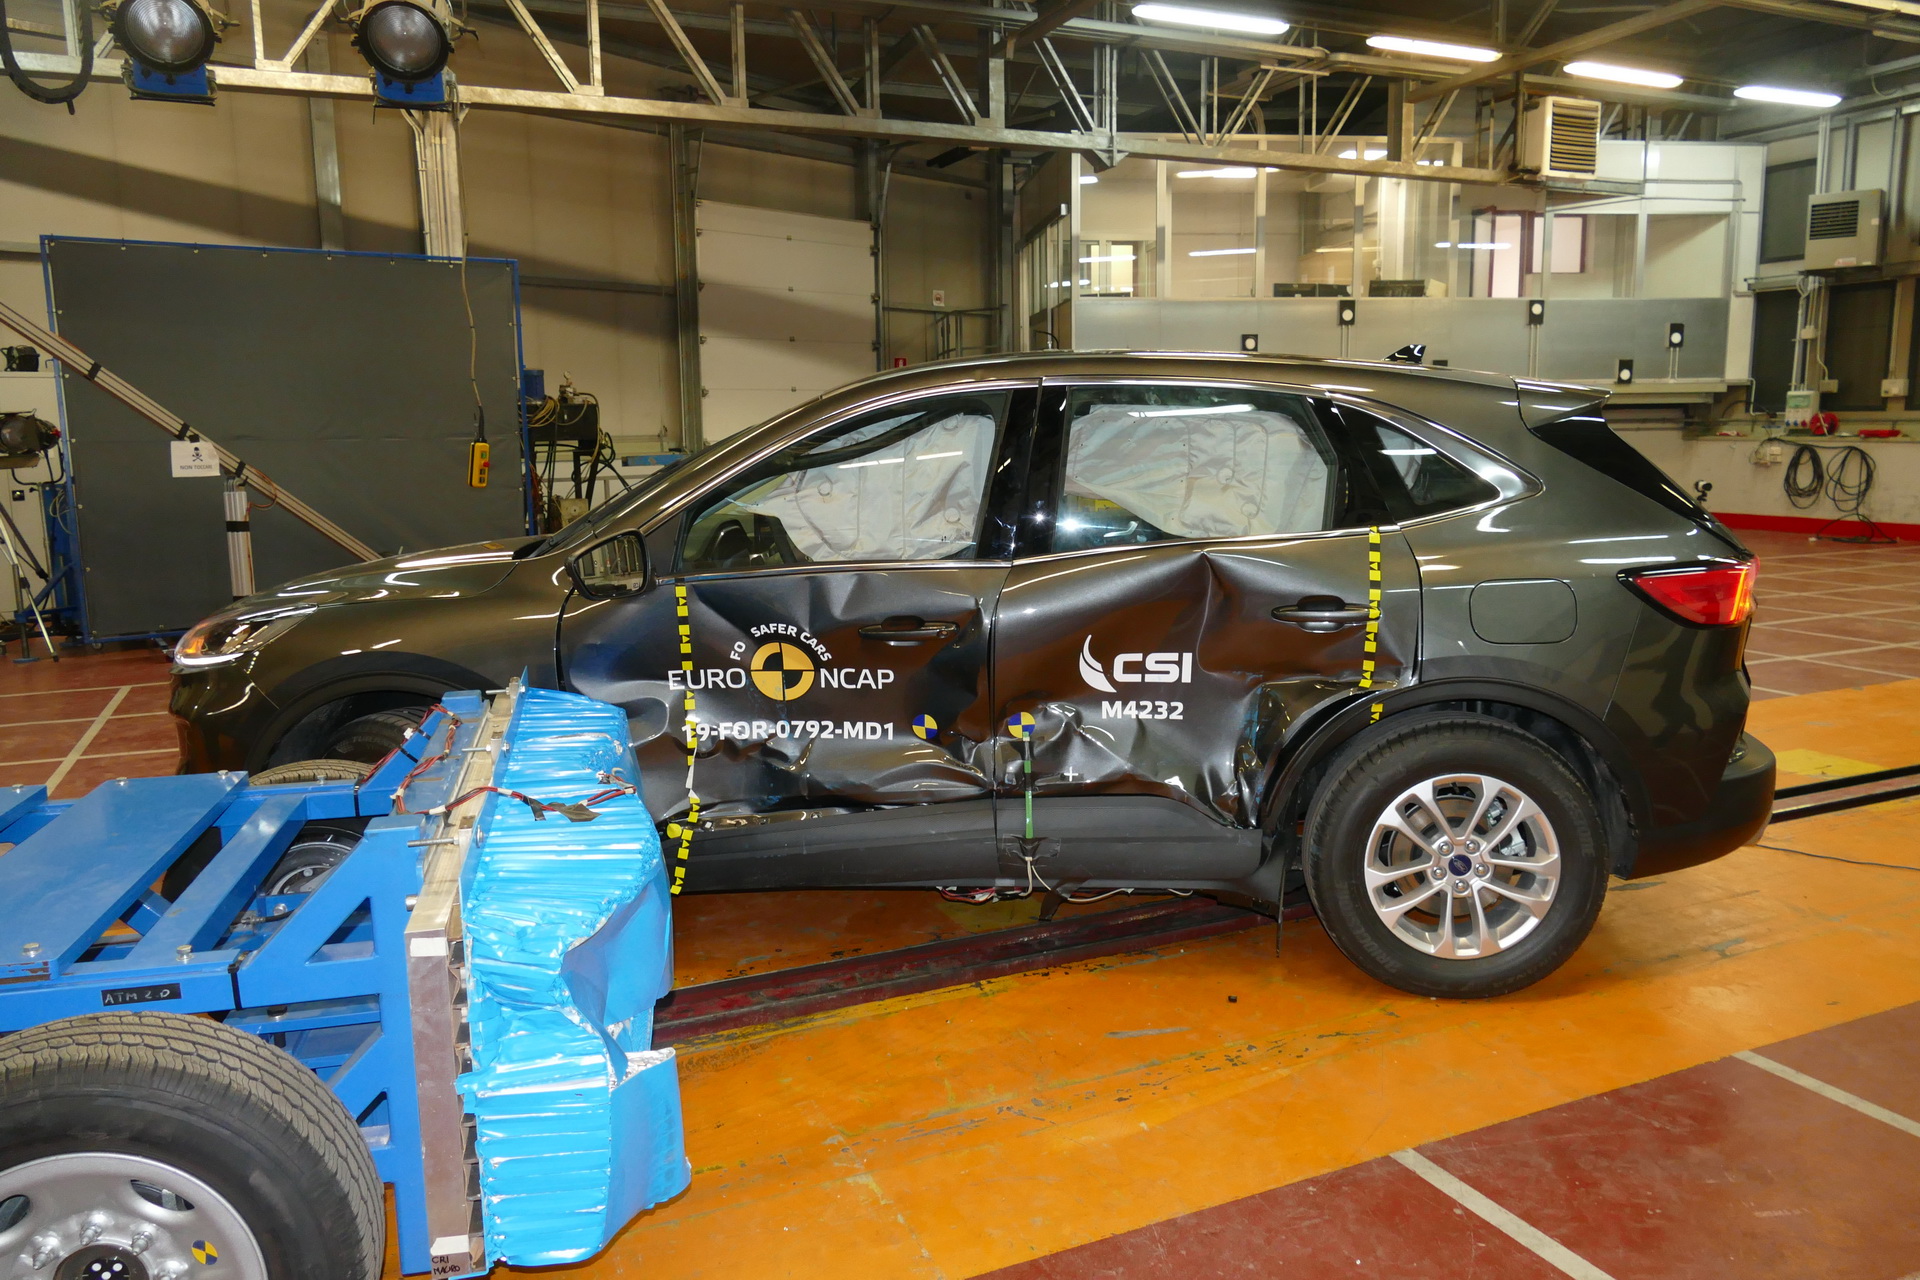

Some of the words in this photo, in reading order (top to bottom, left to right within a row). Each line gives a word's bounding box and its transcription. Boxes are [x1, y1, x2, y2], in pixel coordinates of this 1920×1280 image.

[750, 623, 798, 638] SAFER
[800, 631, 832, 662] CARS
[667, 667, 747, 691] EURO
[820, 668, 895, 690] NCAP
[1113, 652, 1193, 683] CSI
[1101, 700, 1184, 720] M4232
[681, 719, 895, 743] 19-FOR-0792-MD1
[104, 991, 138, 1004] ATM
[431, 1255, 450, 1264] CRI
